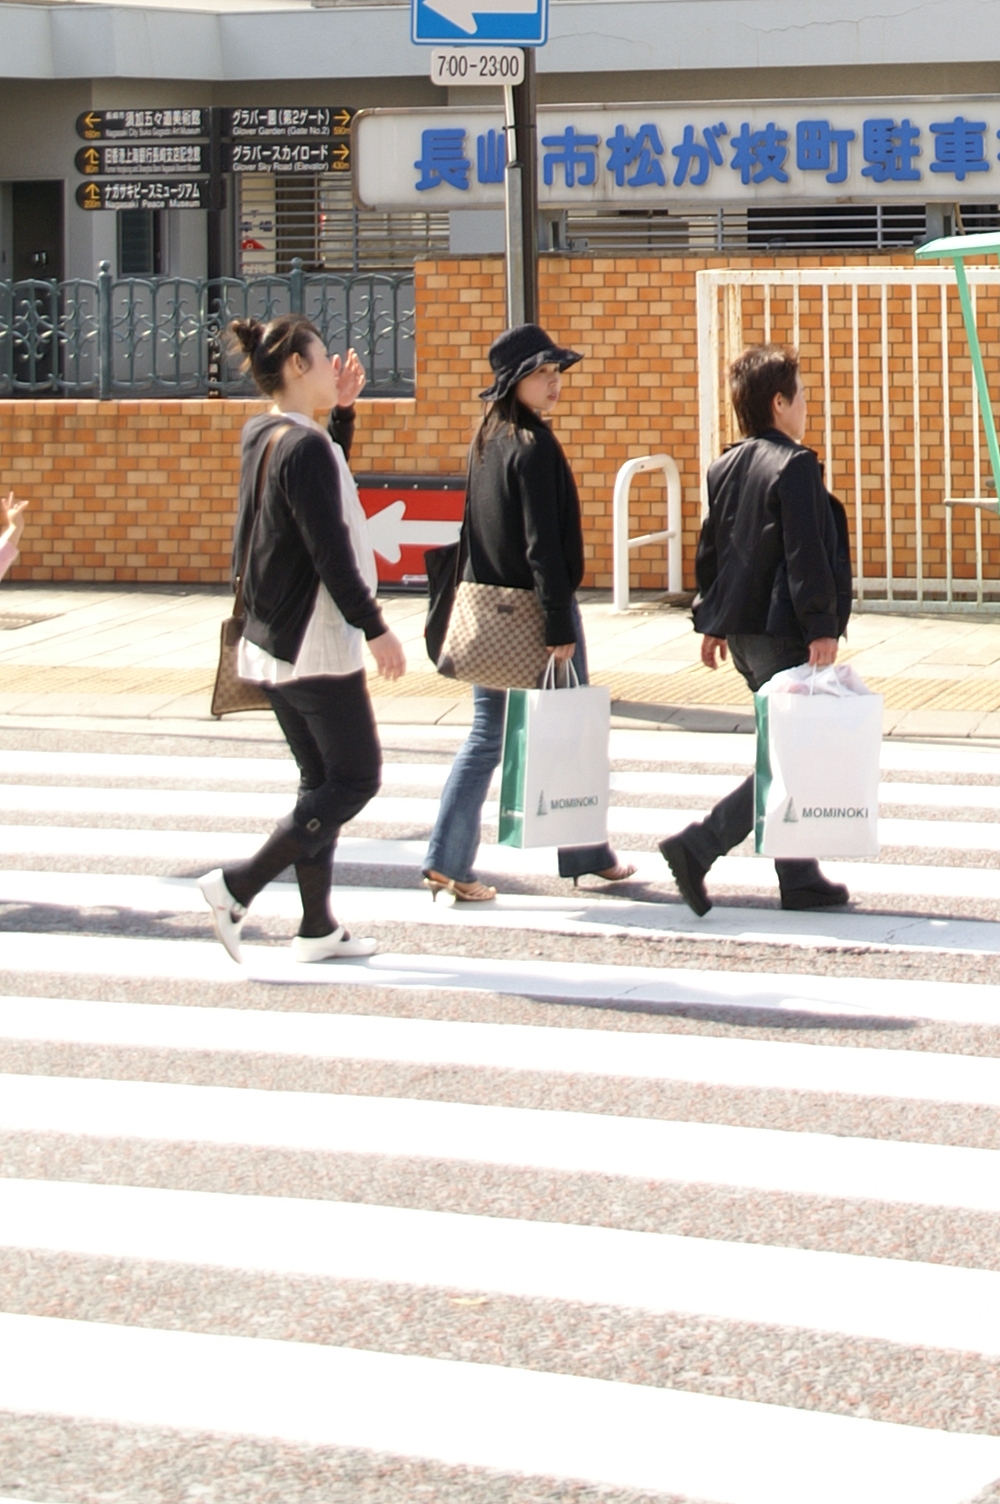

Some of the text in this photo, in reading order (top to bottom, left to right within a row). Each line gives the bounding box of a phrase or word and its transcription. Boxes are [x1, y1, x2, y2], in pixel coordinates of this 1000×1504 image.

[437, 55, 520, 78] 7:00-23:00
[232, 144, 329, 162] グラバースカイロード
[550, 795, 598, 810] MOMINOKI
[801, 806, 869, 819] MOMINOKI
